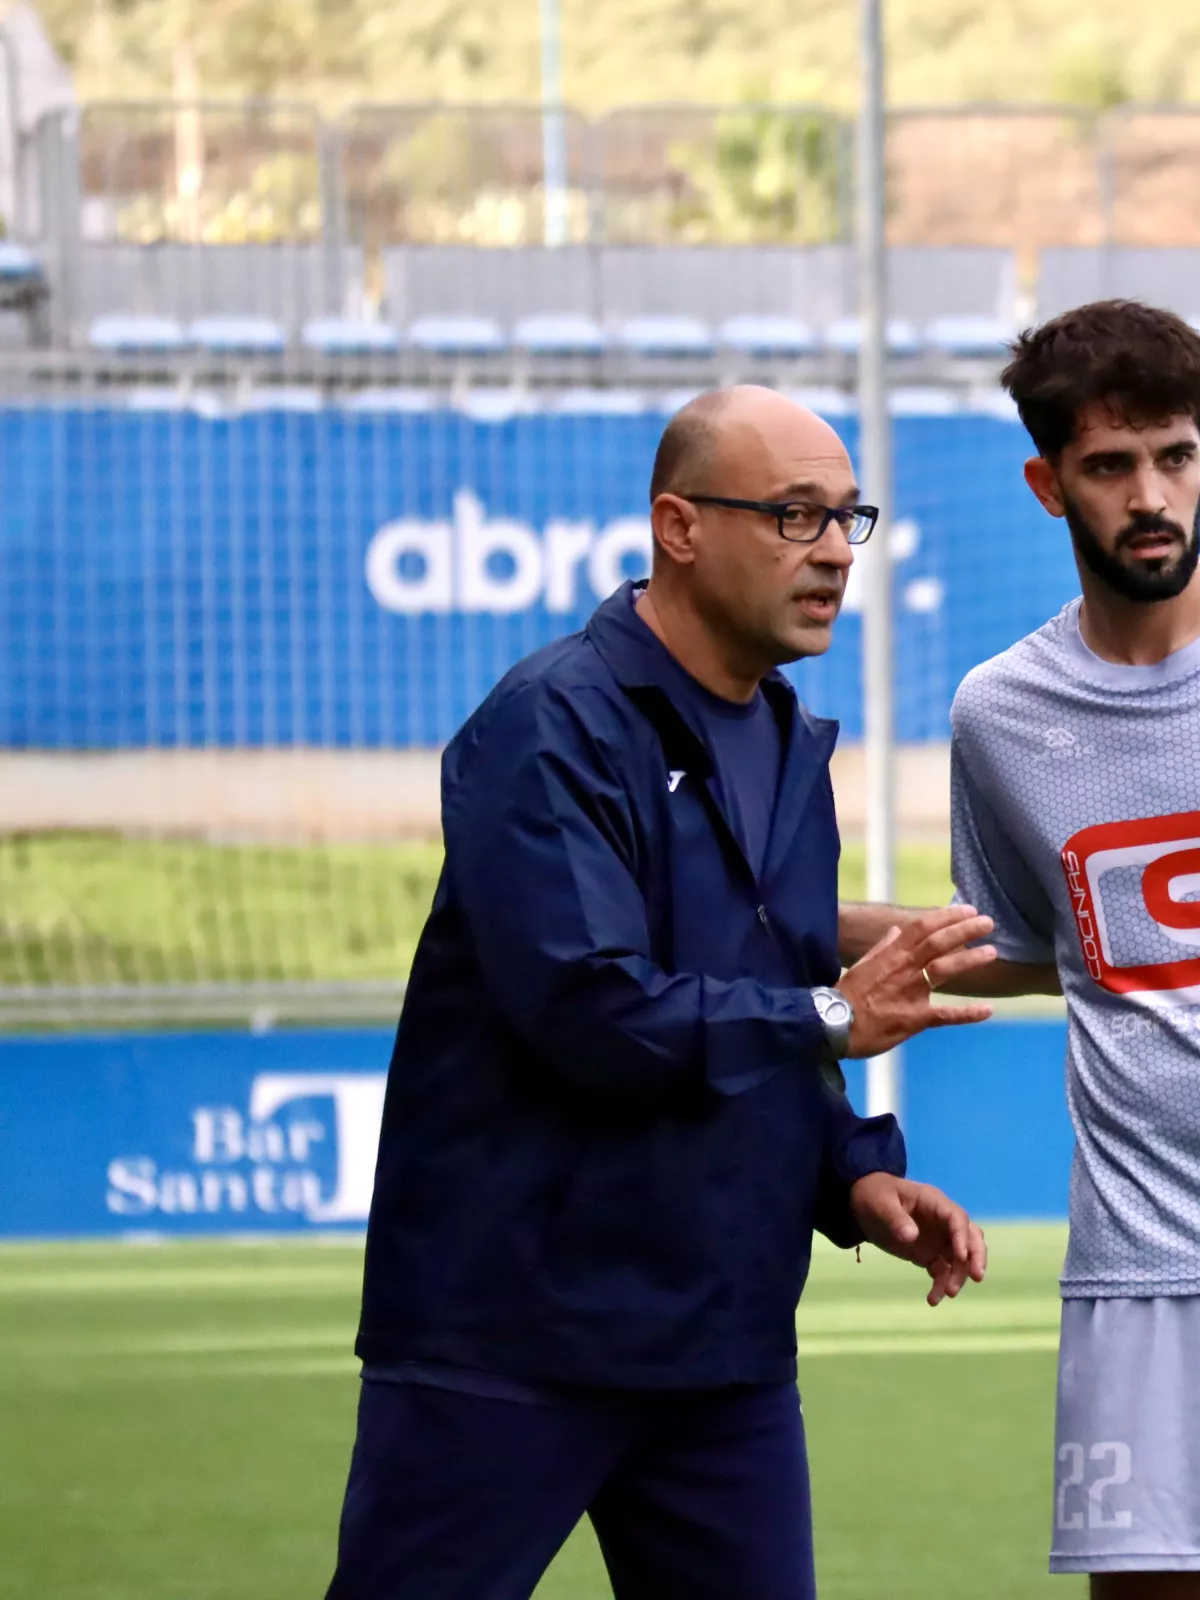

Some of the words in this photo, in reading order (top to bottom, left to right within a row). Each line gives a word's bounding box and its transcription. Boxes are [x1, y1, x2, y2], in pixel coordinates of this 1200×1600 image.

[1062, 851, 1102, 981] COCINAS
[193, 1107, 325, 1164] Bar
[105, 1155, 322, 1214] Santa
[1057, 1441, 1131, 1529] 22
